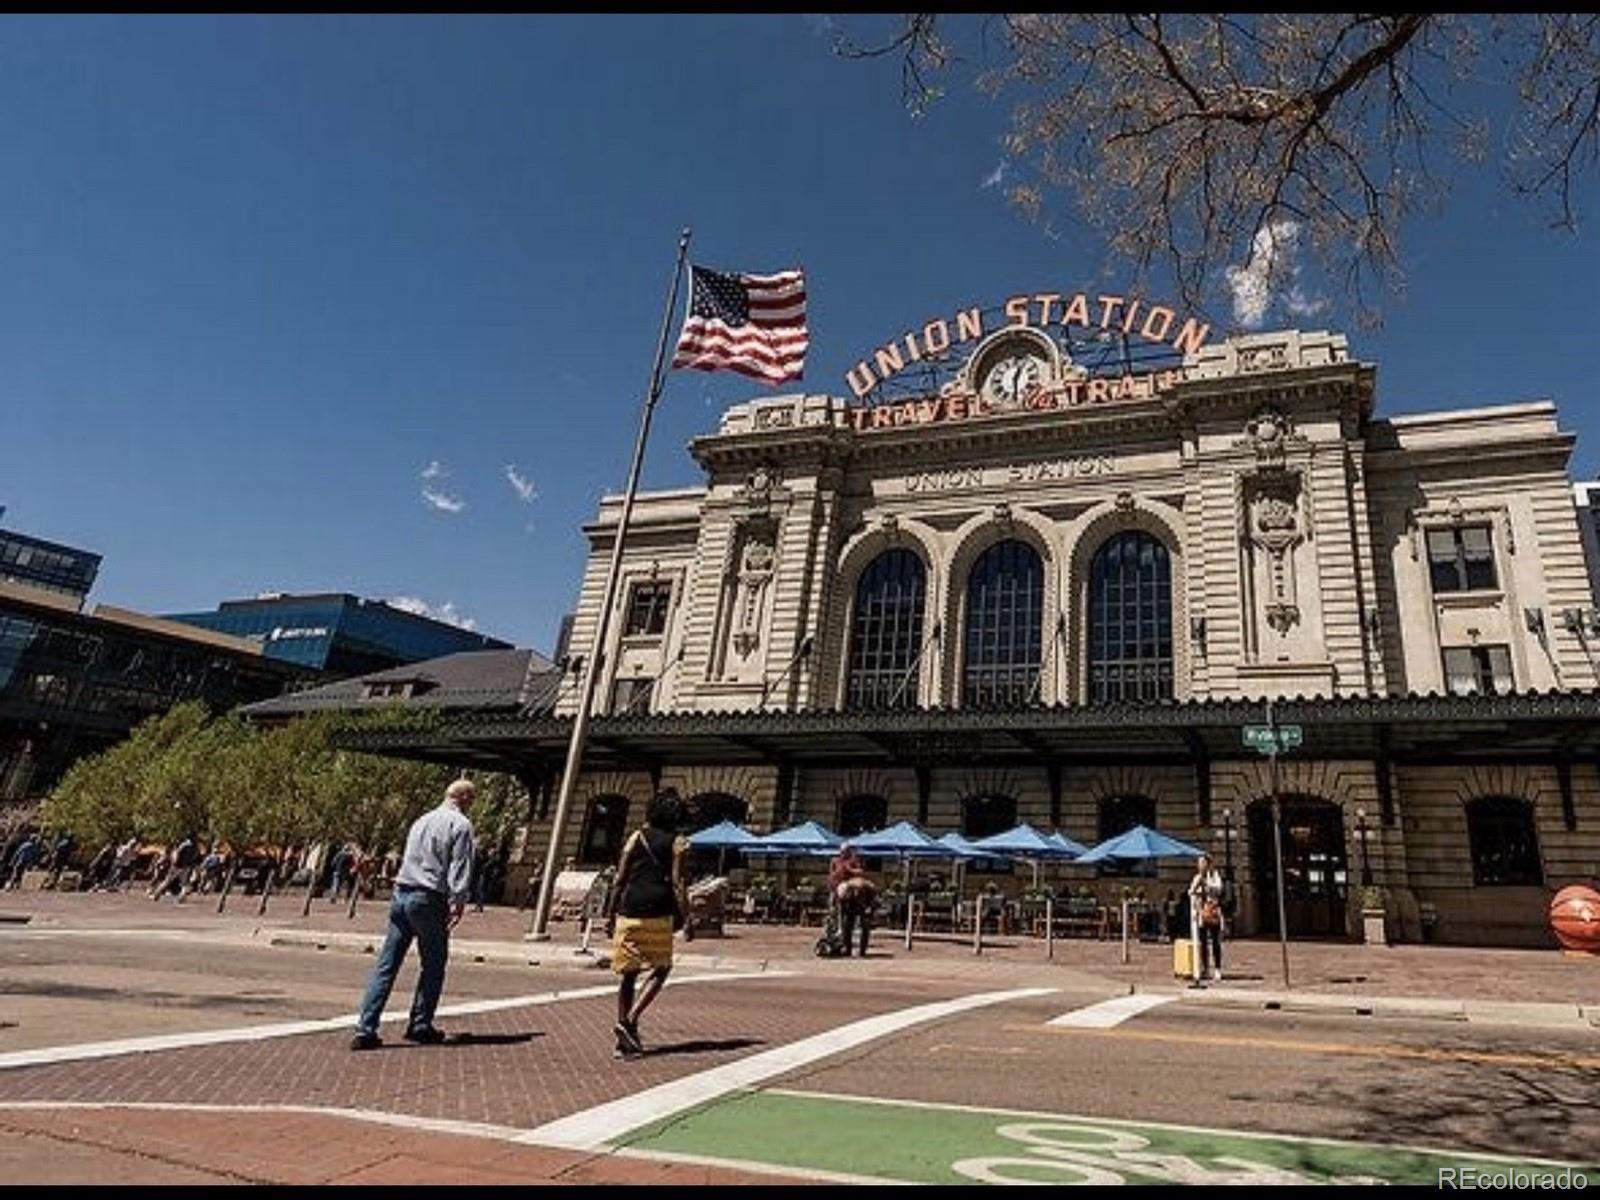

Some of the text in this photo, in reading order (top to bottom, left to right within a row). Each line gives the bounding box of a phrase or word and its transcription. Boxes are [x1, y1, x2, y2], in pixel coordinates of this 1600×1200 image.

[845, 293, 1211, 397] UNION STATION
[851, 393, 990, 431] TRAVEL
[905, 455, 1115, 492] UNION STATION
